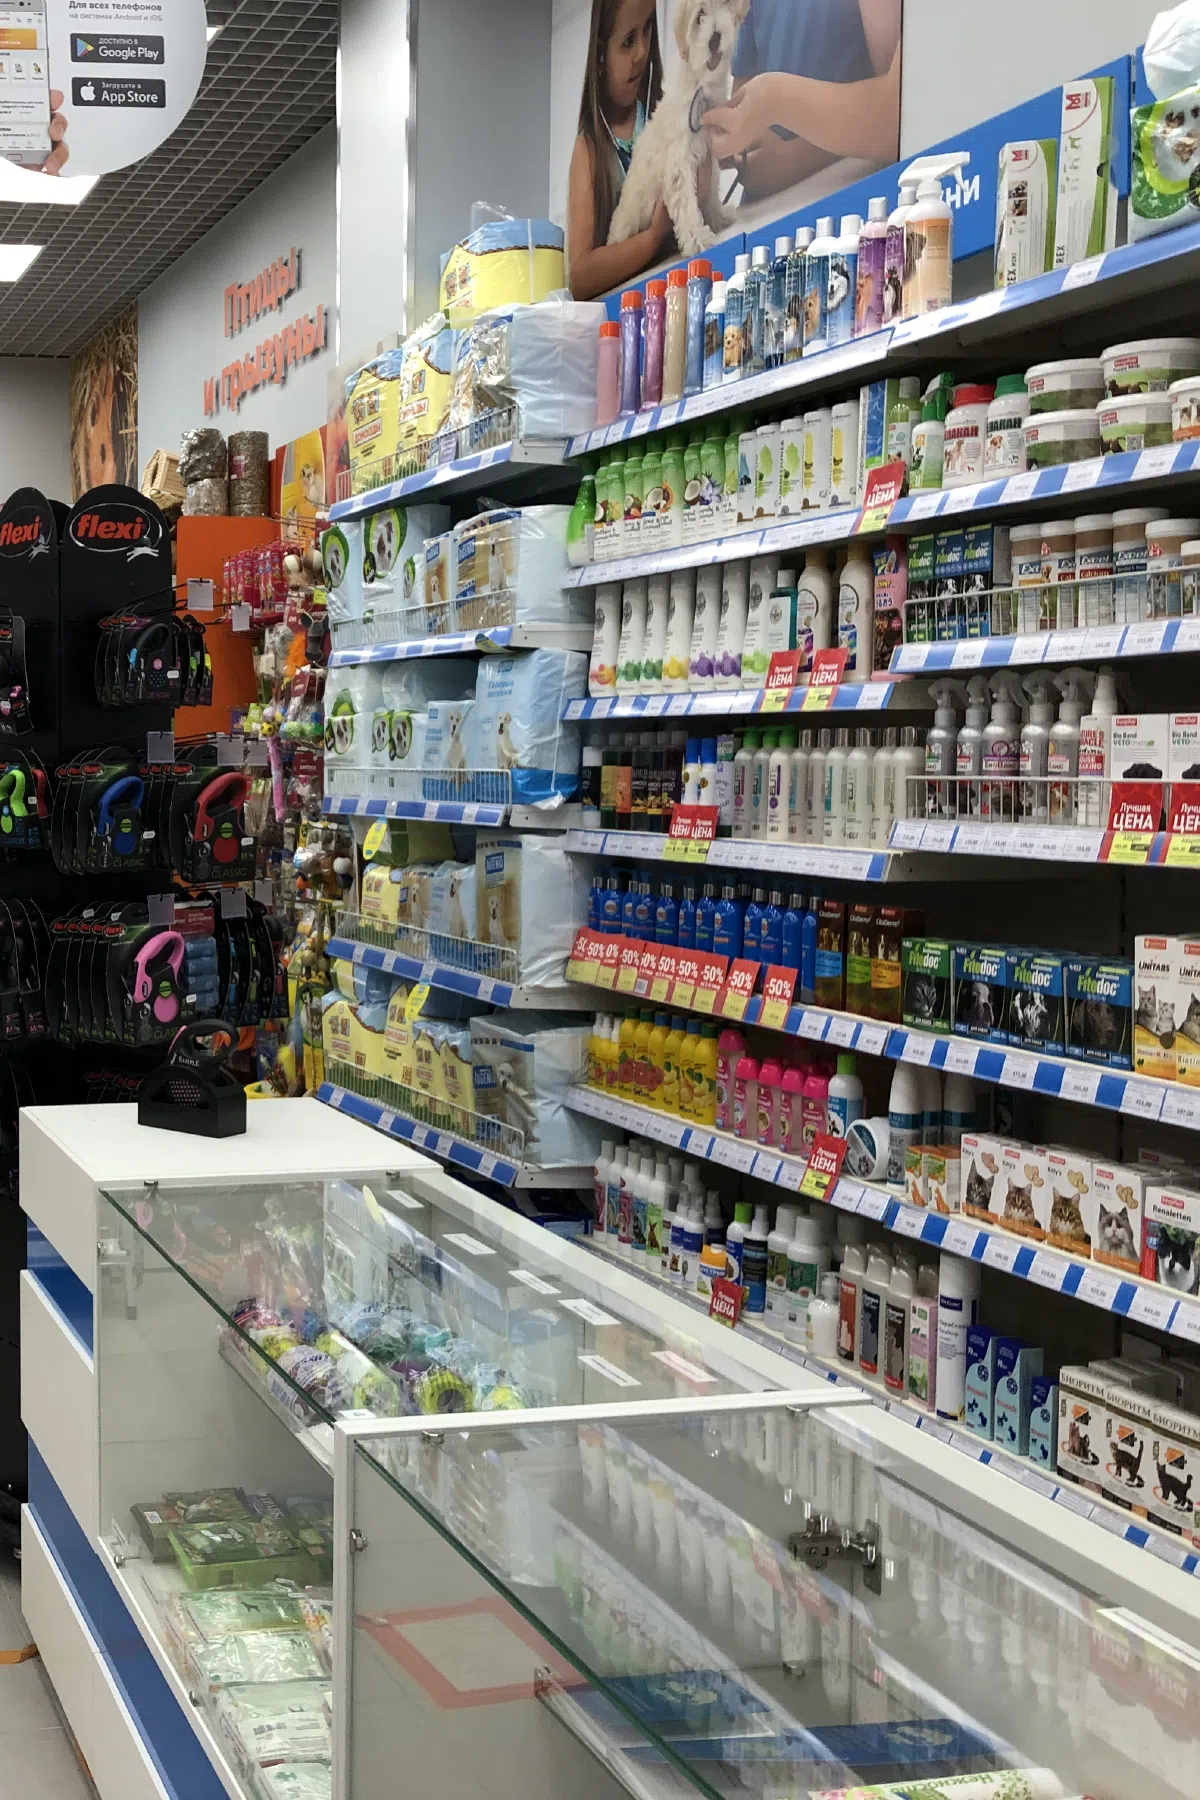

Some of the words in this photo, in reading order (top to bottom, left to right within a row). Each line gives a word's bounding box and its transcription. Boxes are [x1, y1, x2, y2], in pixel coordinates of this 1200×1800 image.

[69, 1, 87, 9] Для
[112, 3, 162, 11] телефонов
[99, 46, 136, 60] Google
[138, 47, 159, 60] Play
[102, 82, 136, 90] Загрузите
[102, 90, 126, 105] App
[127, 91, 159, 103] Store
[224, 247, 296, 337] Птицы
[204, 376, 214, 416] и
[221, 304, 324, 411] грызуны
[866, 489, 895, 508] ЦЕНА
[0, 516, 41, 547] flexi
[77, 513, 144, 540] flexi
[769, 672, 793, 688] ЦЕНА
[812, 671, 838, 686] ЦЕНА
[1121, 802, 1152, 814] Лучшая
[691, 825, 713, 839] ЦЕНА
[1112, 814, 1154, 833] ЦЕНА
[1172, 814, 1200, 832] ЦЕН
[211, 867, 248, 878] CLASSIC
[909, 951, 942, 969] Fitodoc
[963, 955, 1000, 978] Fitodoc
[1139, 960, 1171, 973] UNITABS
[676, 961, 699, 979] -50%
[701, 964, 724, 984] -50%
[729, 969, 752, 989] -50%
[1014, 966, 1052, 988] Fitodoc
[766, 977, 791, 998] -50%
[1077, 974, 1120, 997] Fitodoc
[178, 1055, 200, 1067] SAMPLE
[810, 1155, 837, 1174] ЦЕНА
[1153, 1205, 1192, 1223] Renaletten
[712, 1299, 735, 1318] ЦЕНА
[1061, 1372, 1105, 1397] БИОРИТМ
[1107, 1392, 1151, 1417] БИОРИТМ
